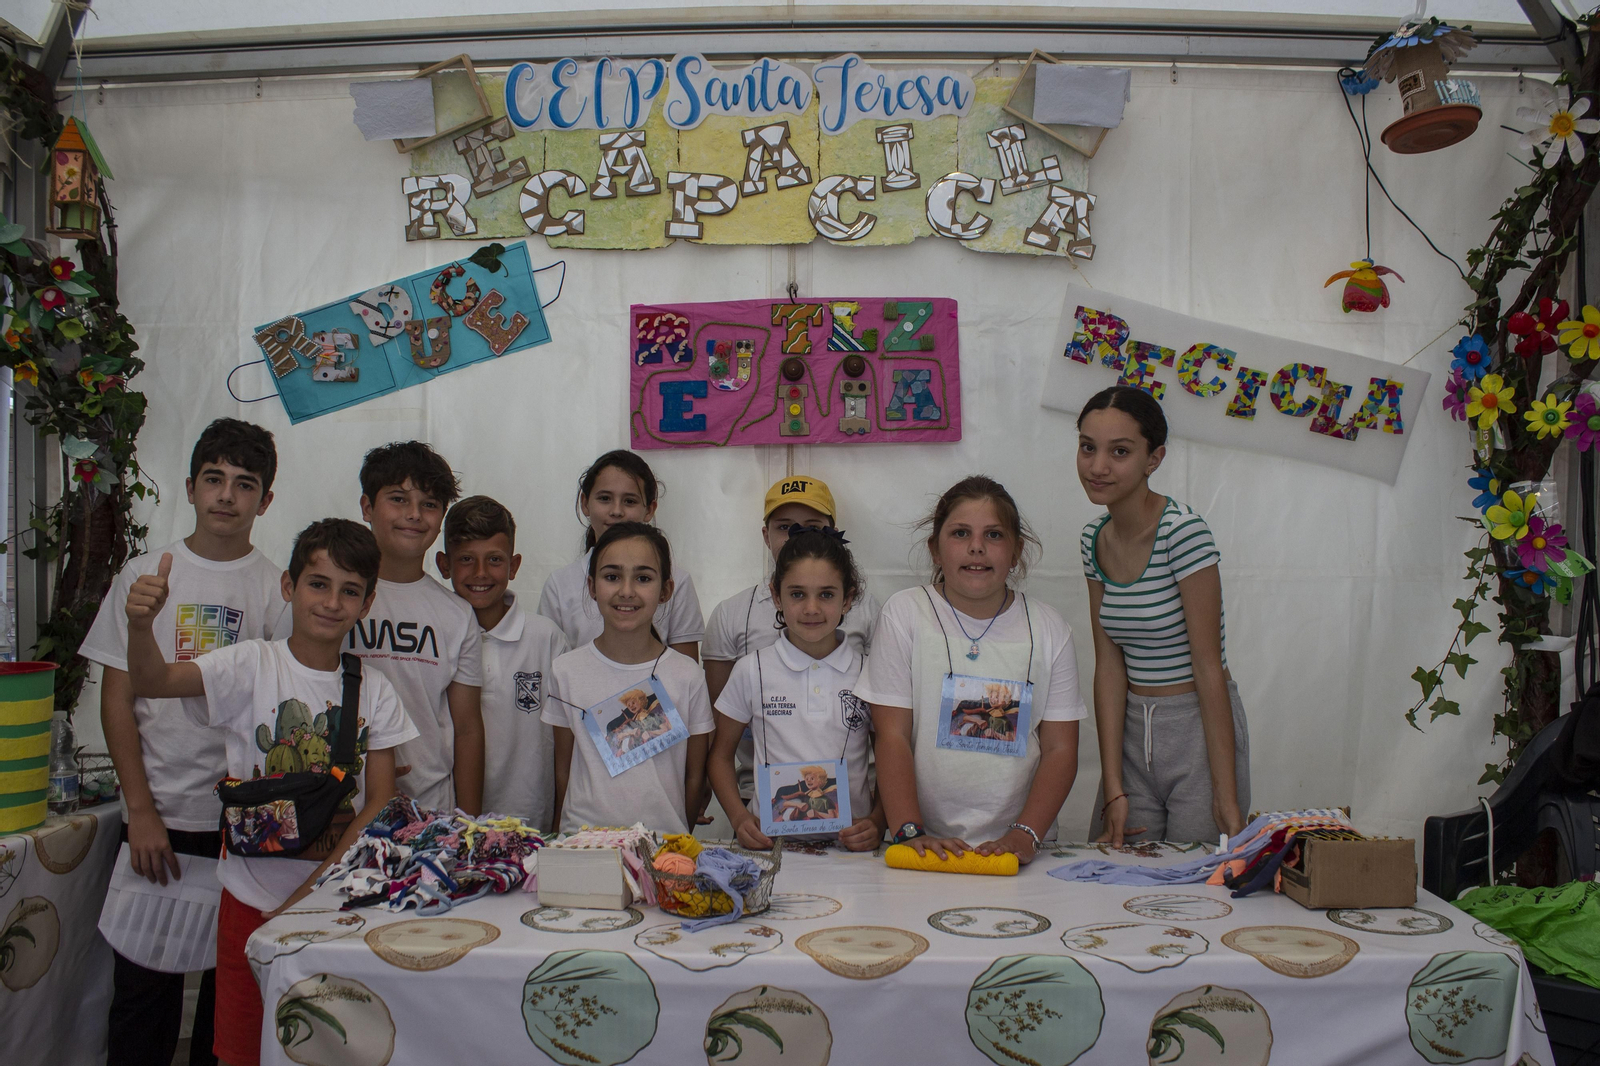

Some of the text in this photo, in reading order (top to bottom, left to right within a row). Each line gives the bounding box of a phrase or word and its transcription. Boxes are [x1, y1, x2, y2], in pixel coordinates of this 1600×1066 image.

[505, 55, 970, 132] CEIP Santa Teresa
[252, 261, 530, 383] REDUCE
[1063, 304, 1405, 442] RECICLA
[781, 480, 808, 495] CAT
[349, 618, 440, 658] NASA
[781, 824, 799, 834] Santa
[801, 823, 817, 832] Teresa
[819, 822, 826, 831] de
